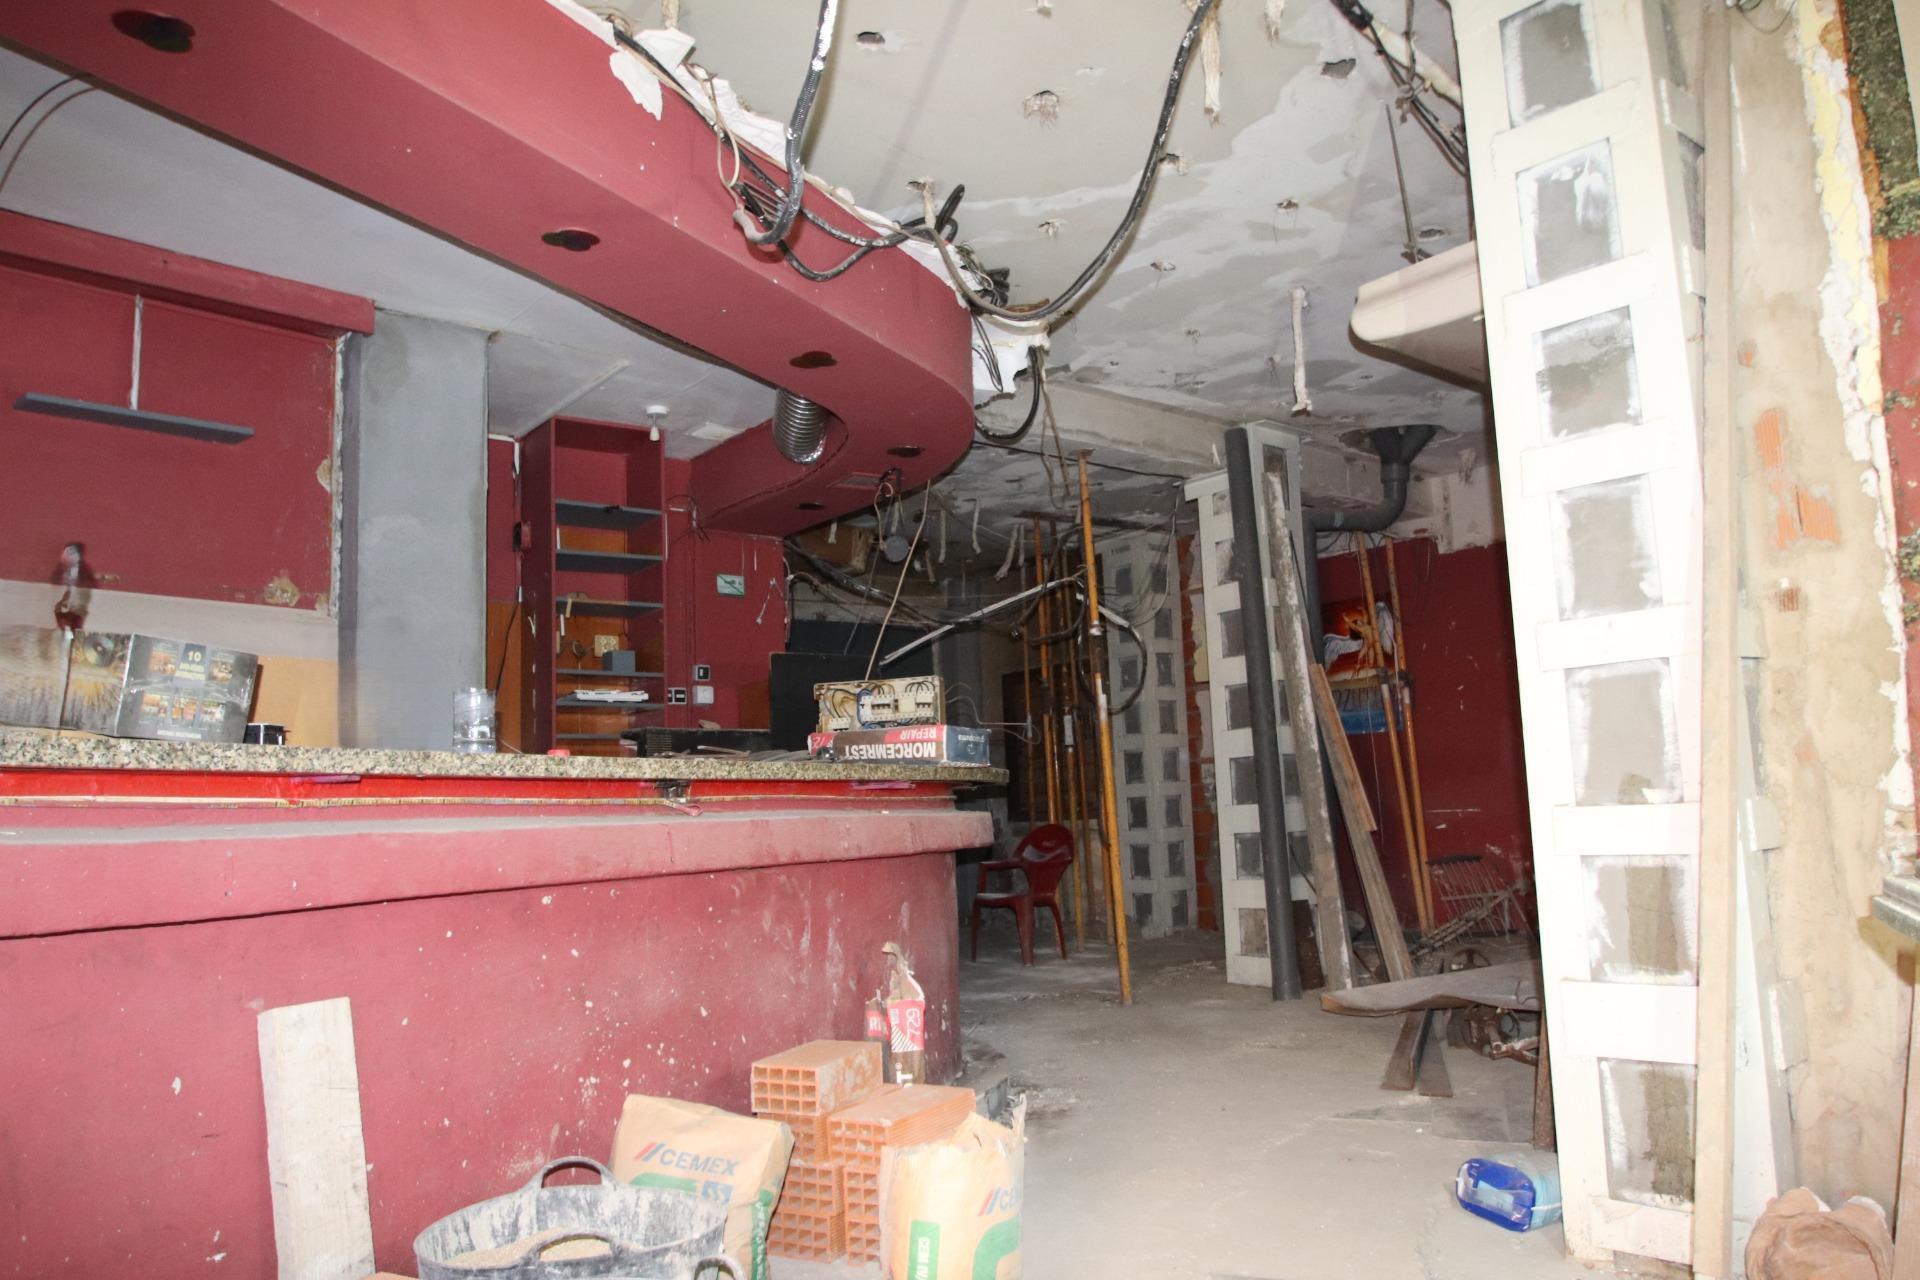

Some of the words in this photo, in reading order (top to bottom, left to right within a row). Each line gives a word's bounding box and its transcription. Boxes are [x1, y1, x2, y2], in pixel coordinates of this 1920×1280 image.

[187, 651, 202, 662] 10
[900, 727, 936, 740] REPAIR
[845, 742, 936, 760] MORCEMREST
[660, 1148, 739, 1176] CEMEX
